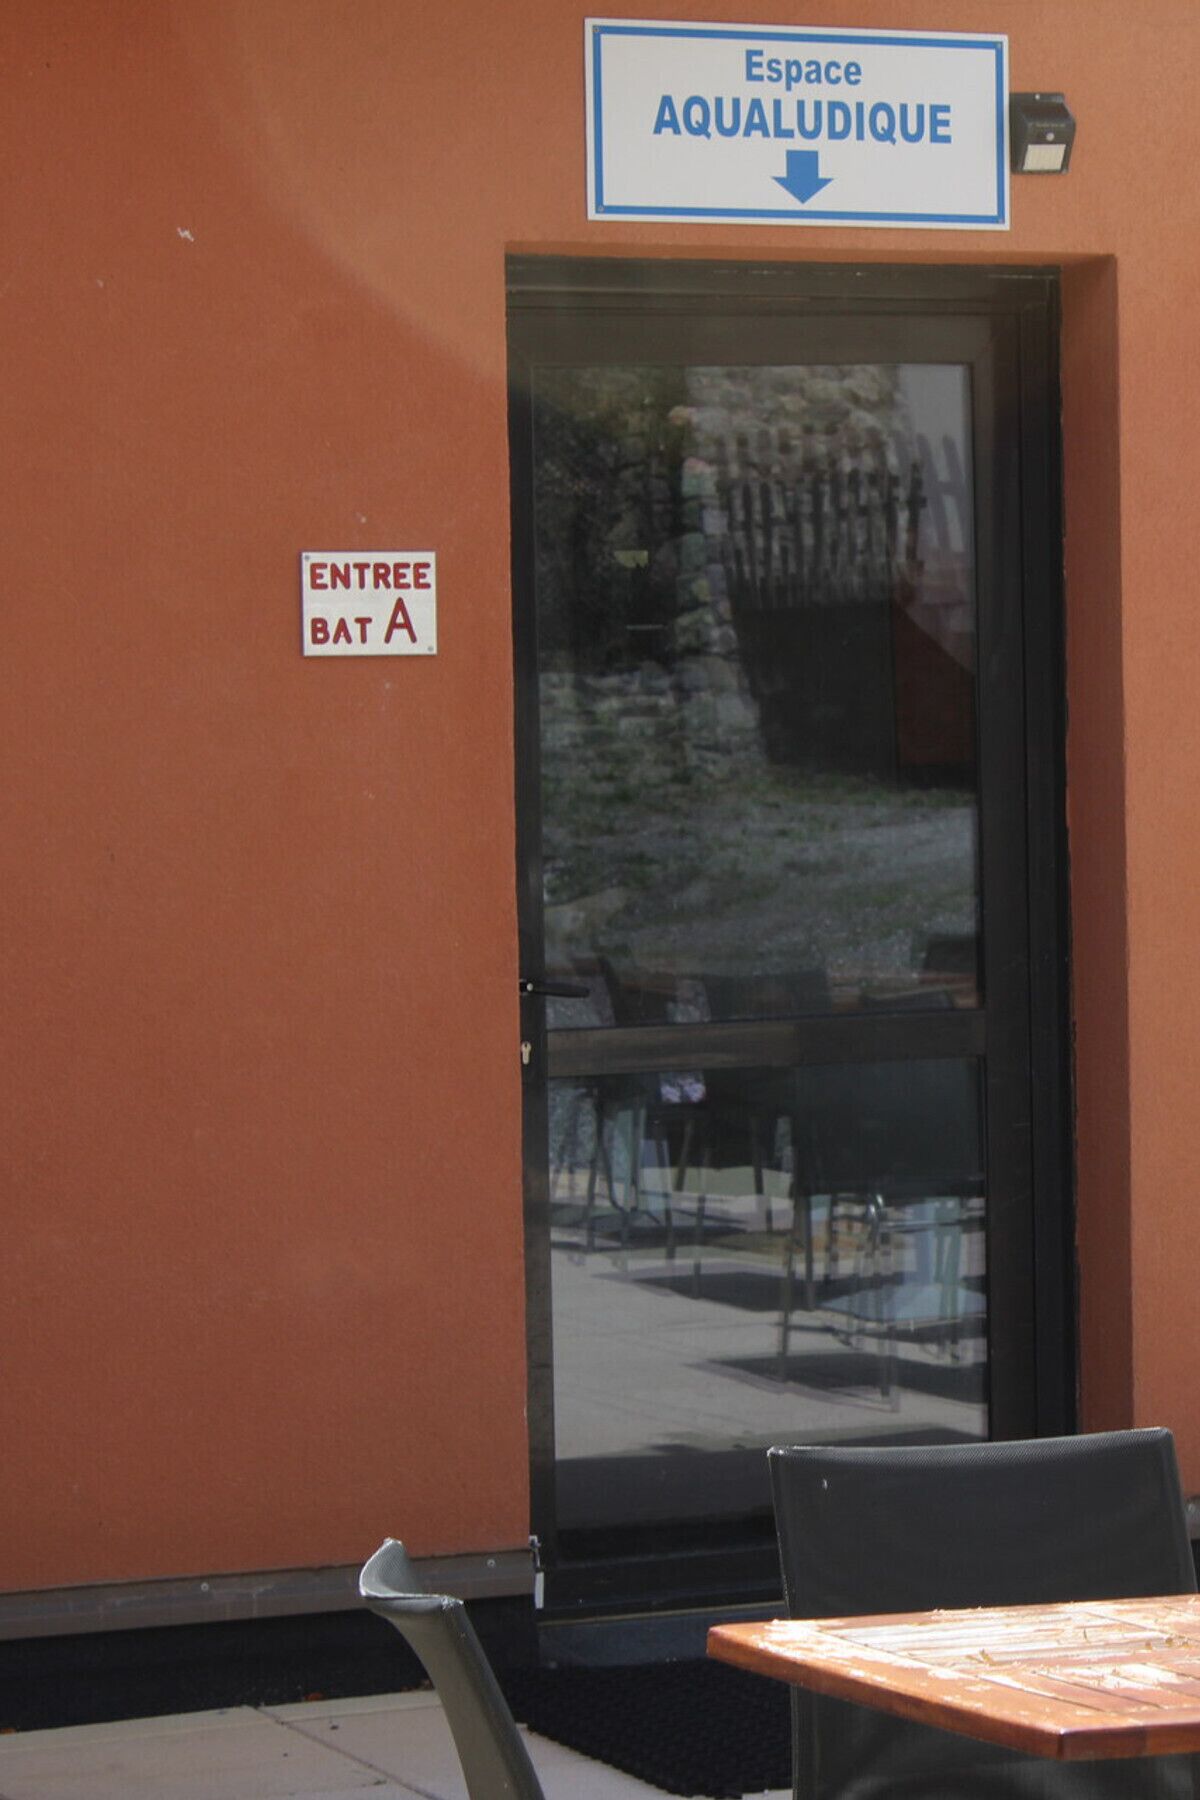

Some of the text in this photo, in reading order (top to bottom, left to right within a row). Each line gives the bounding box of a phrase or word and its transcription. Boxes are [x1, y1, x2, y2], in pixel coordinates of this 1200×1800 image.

[745, 49, 863, 91] Espace
[653, 95, 952, 144] AQUALUDIQUE
[310, 562, 432, 590] ENTREE
[310, 597, 417, 645] BAT A
